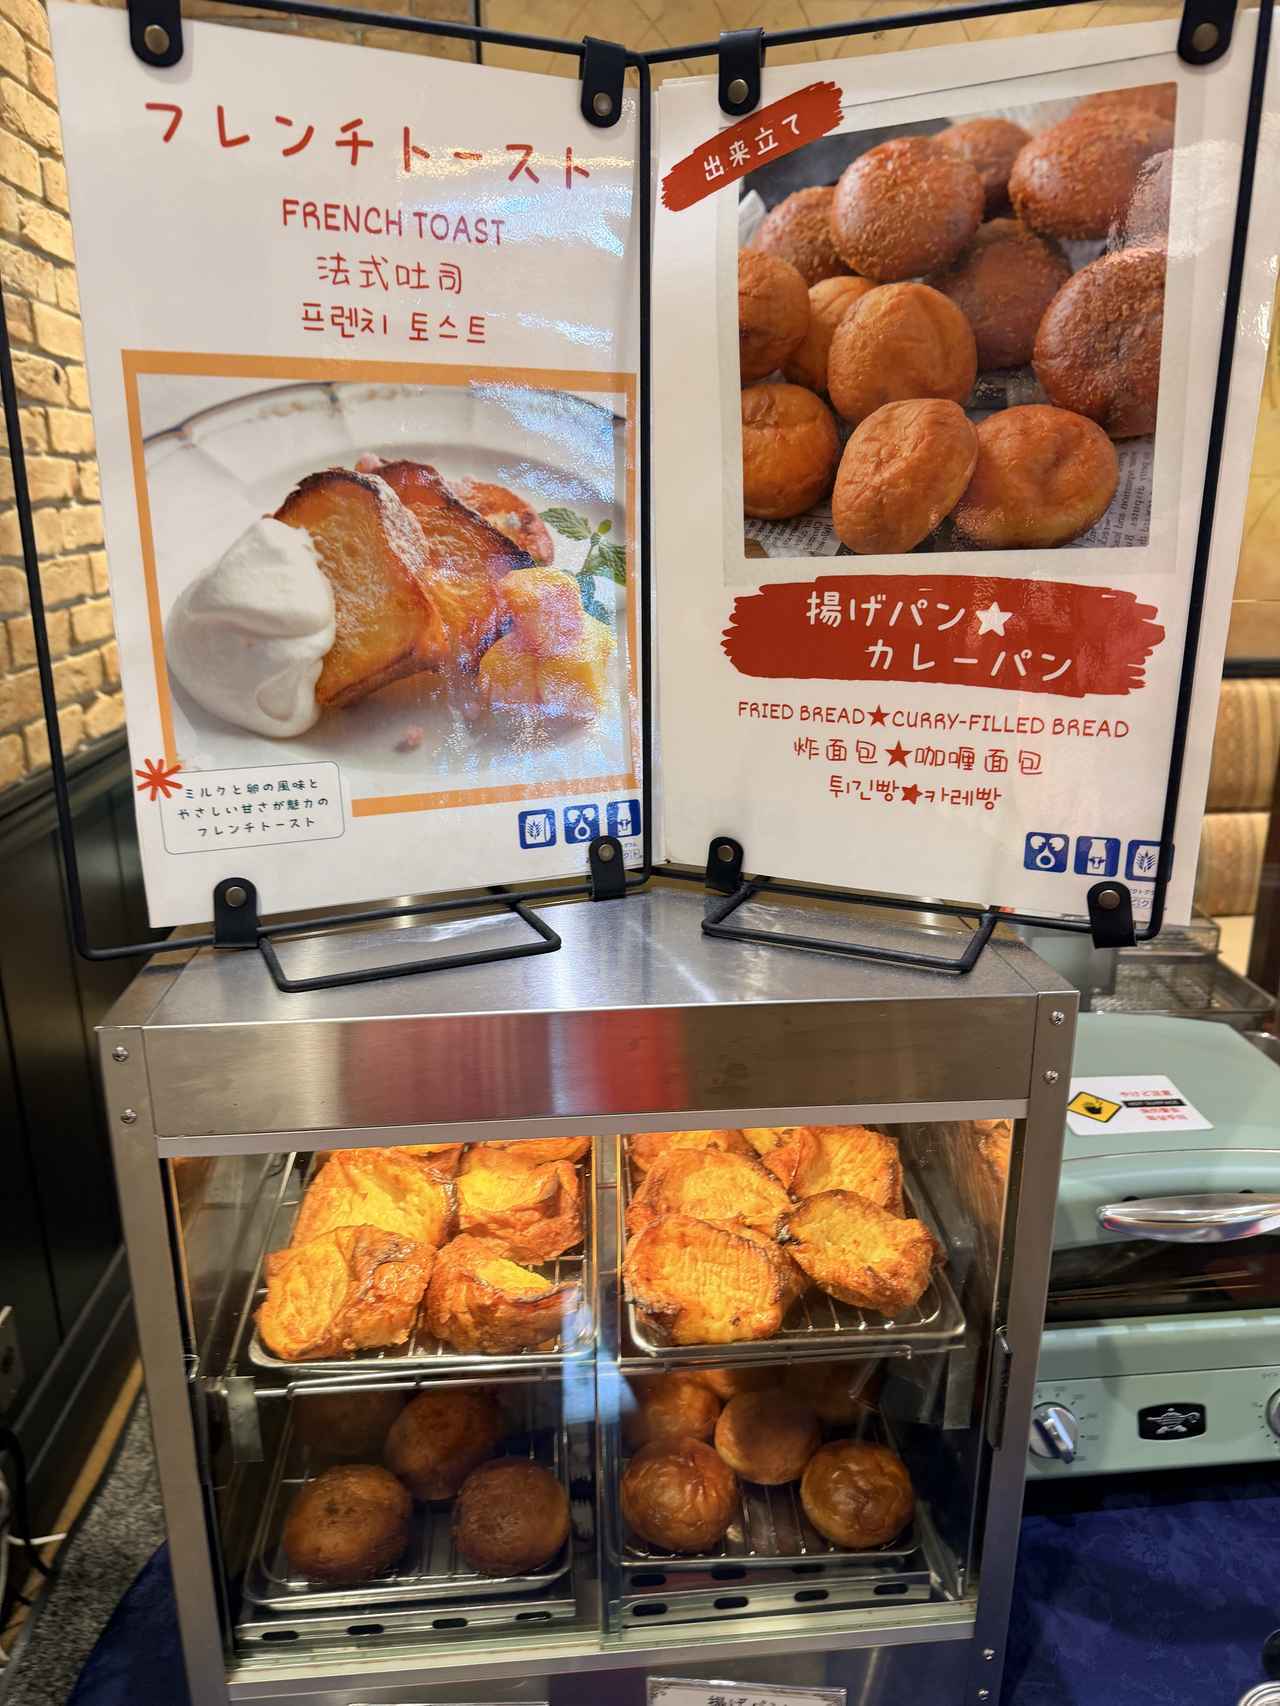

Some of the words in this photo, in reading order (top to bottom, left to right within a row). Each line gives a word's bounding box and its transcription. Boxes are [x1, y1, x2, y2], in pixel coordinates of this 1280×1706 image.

[144, 102, 589, 189] フレンチトースト
[703, 113, 800, 181] 出来立て
[281, 197, 402, 240] FRENCH
[410, 210, 505, 247] TOAST
[316, 252, 464, 295] 法式吐司
[301, 302, 388, 342] 프렌치
[407, 311, 486, 345] 토스트
[806, 591, 966, 632] 揚げパン
[866, 640, 1071, 680] カレーパン
[738, 699, 794, 720] FRIED
[799, 705, 867, 724] BREAD
[891, 709, 1045, 736] CURRY-FILLED
[1050, 716, 1131, 739] BREAD
[793, 736, 878, 764] 炸面包
[914, 745, 1043, 776] 咖喱面包
[178, 798, 328, 819] やさしい甘さが魅力の
[185, 779, 318, 799] ミルクと卵の風味と
[828, 774, 900, 802] 튀긴빵
[924, 786, 1002, 811] 카레빵
[198, 818, 314, 836] フレンチトースト
